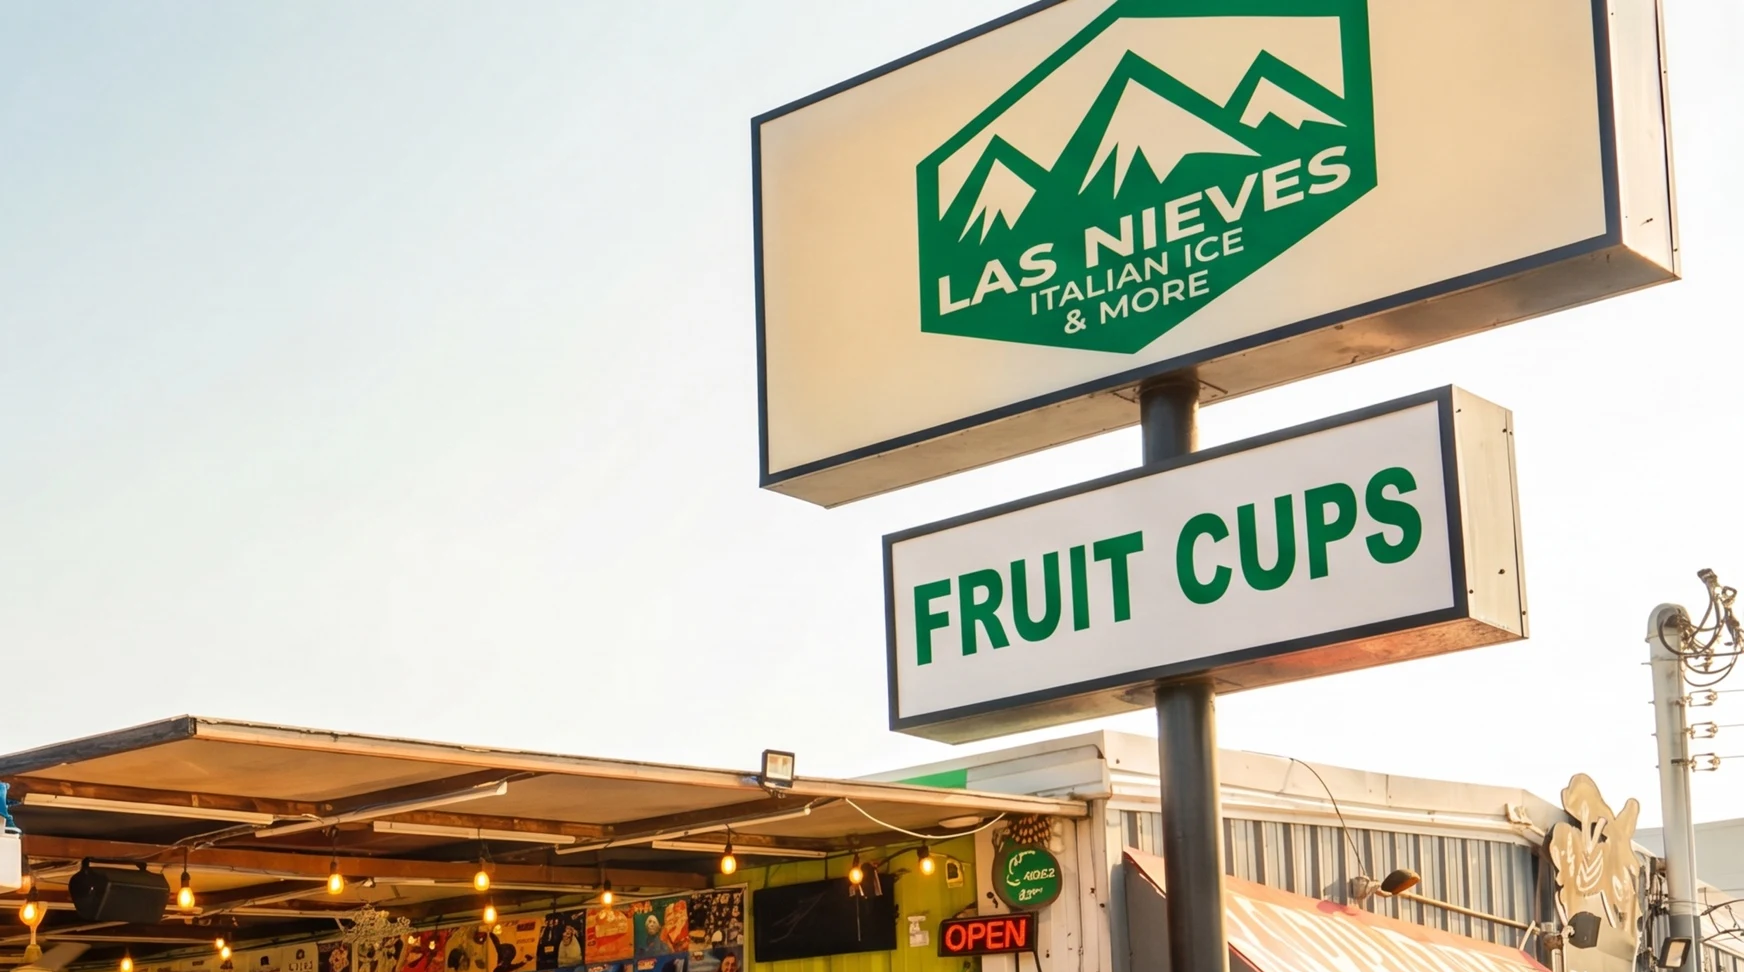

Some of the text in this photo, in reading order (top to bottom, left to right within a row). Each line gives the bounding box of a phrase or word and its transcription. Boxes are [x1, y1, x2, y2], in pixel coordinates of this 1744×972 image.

[938, 145, 1352, 316] LAS NIEVES
[1030, 226, 1245, 316] ITALIAN ICE
[1063, 269, 1210, 335] & MORE
[913, 466, 1423, 666] FRUIT CUPS
[945, 918, 1027, 952] OPEN
